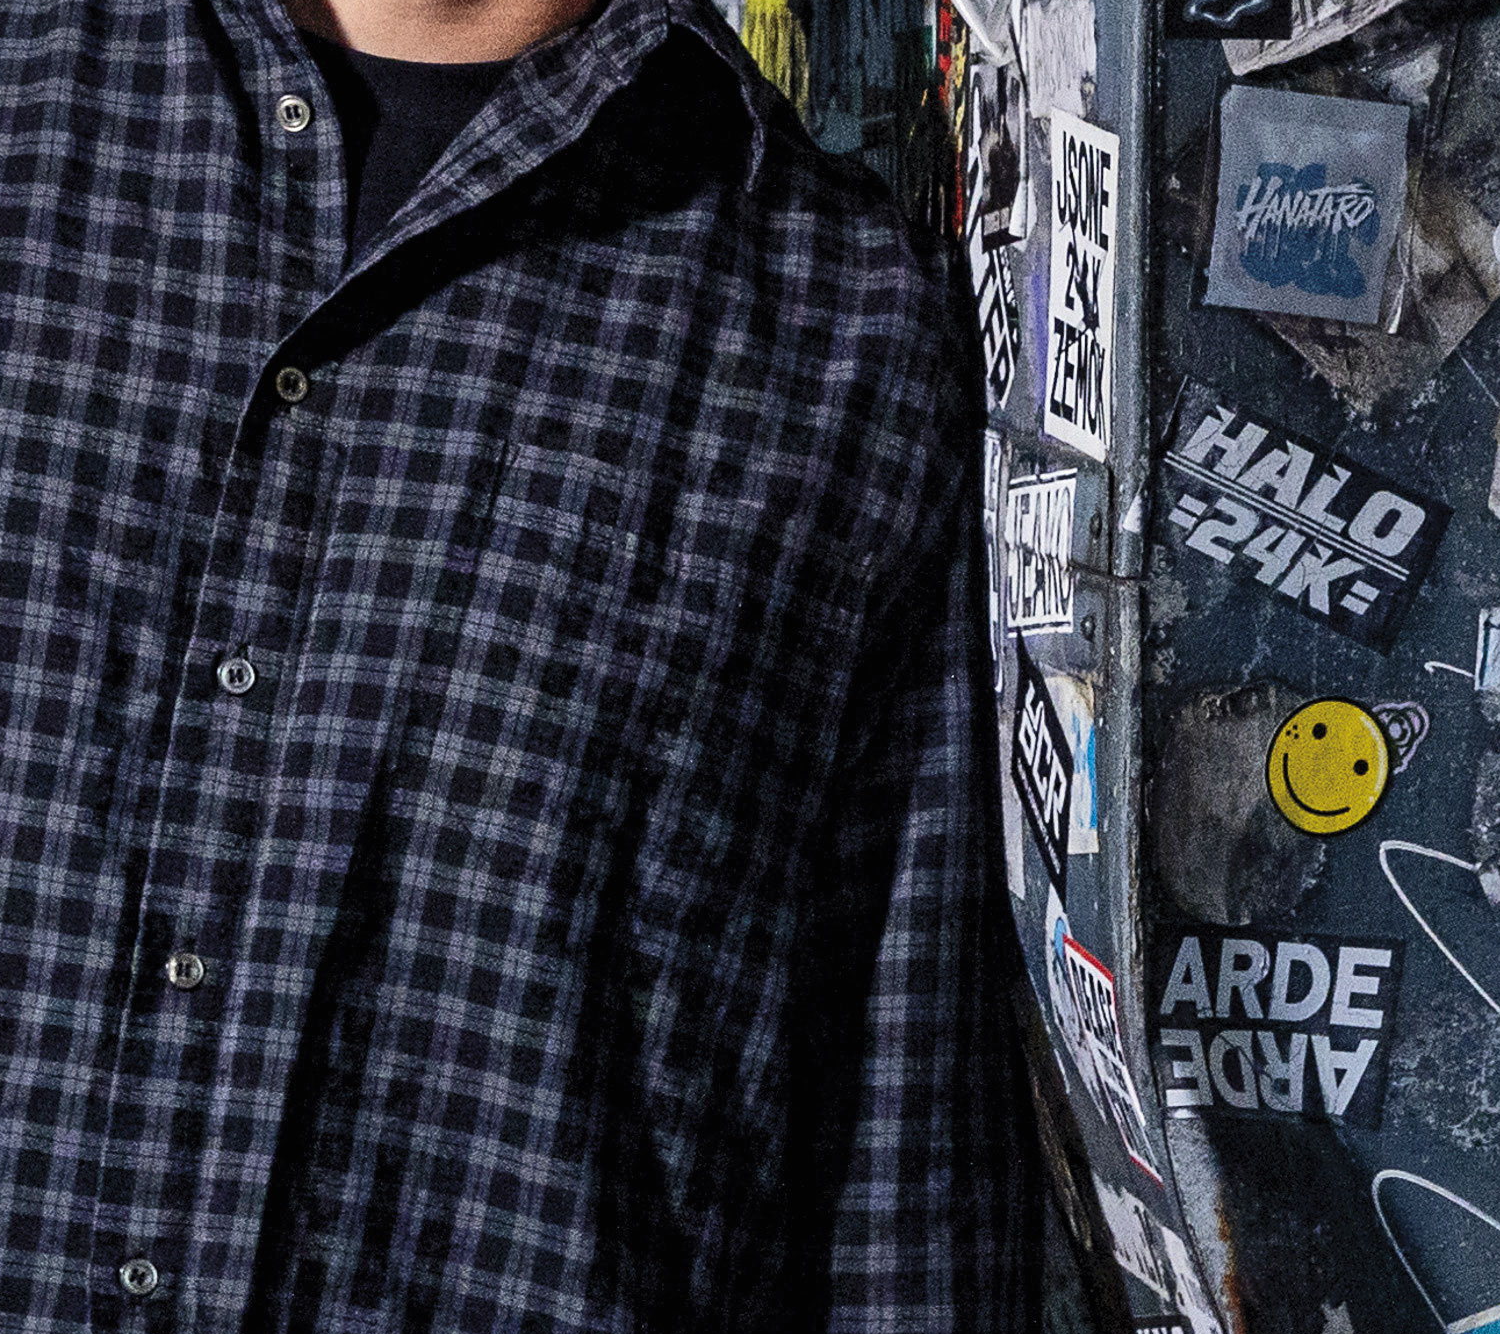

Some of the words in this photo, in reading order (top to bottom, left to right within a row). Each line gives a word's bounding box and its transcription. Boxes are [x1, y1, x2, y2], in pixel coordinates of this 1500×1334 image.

[1056, 131, 1111, 252] JSONE
[1179, 404, 1426, 557] HALO
[1160, 935, 1392, 1030] ARDE
[1160, 1028, 1379, 1116] ARDE
